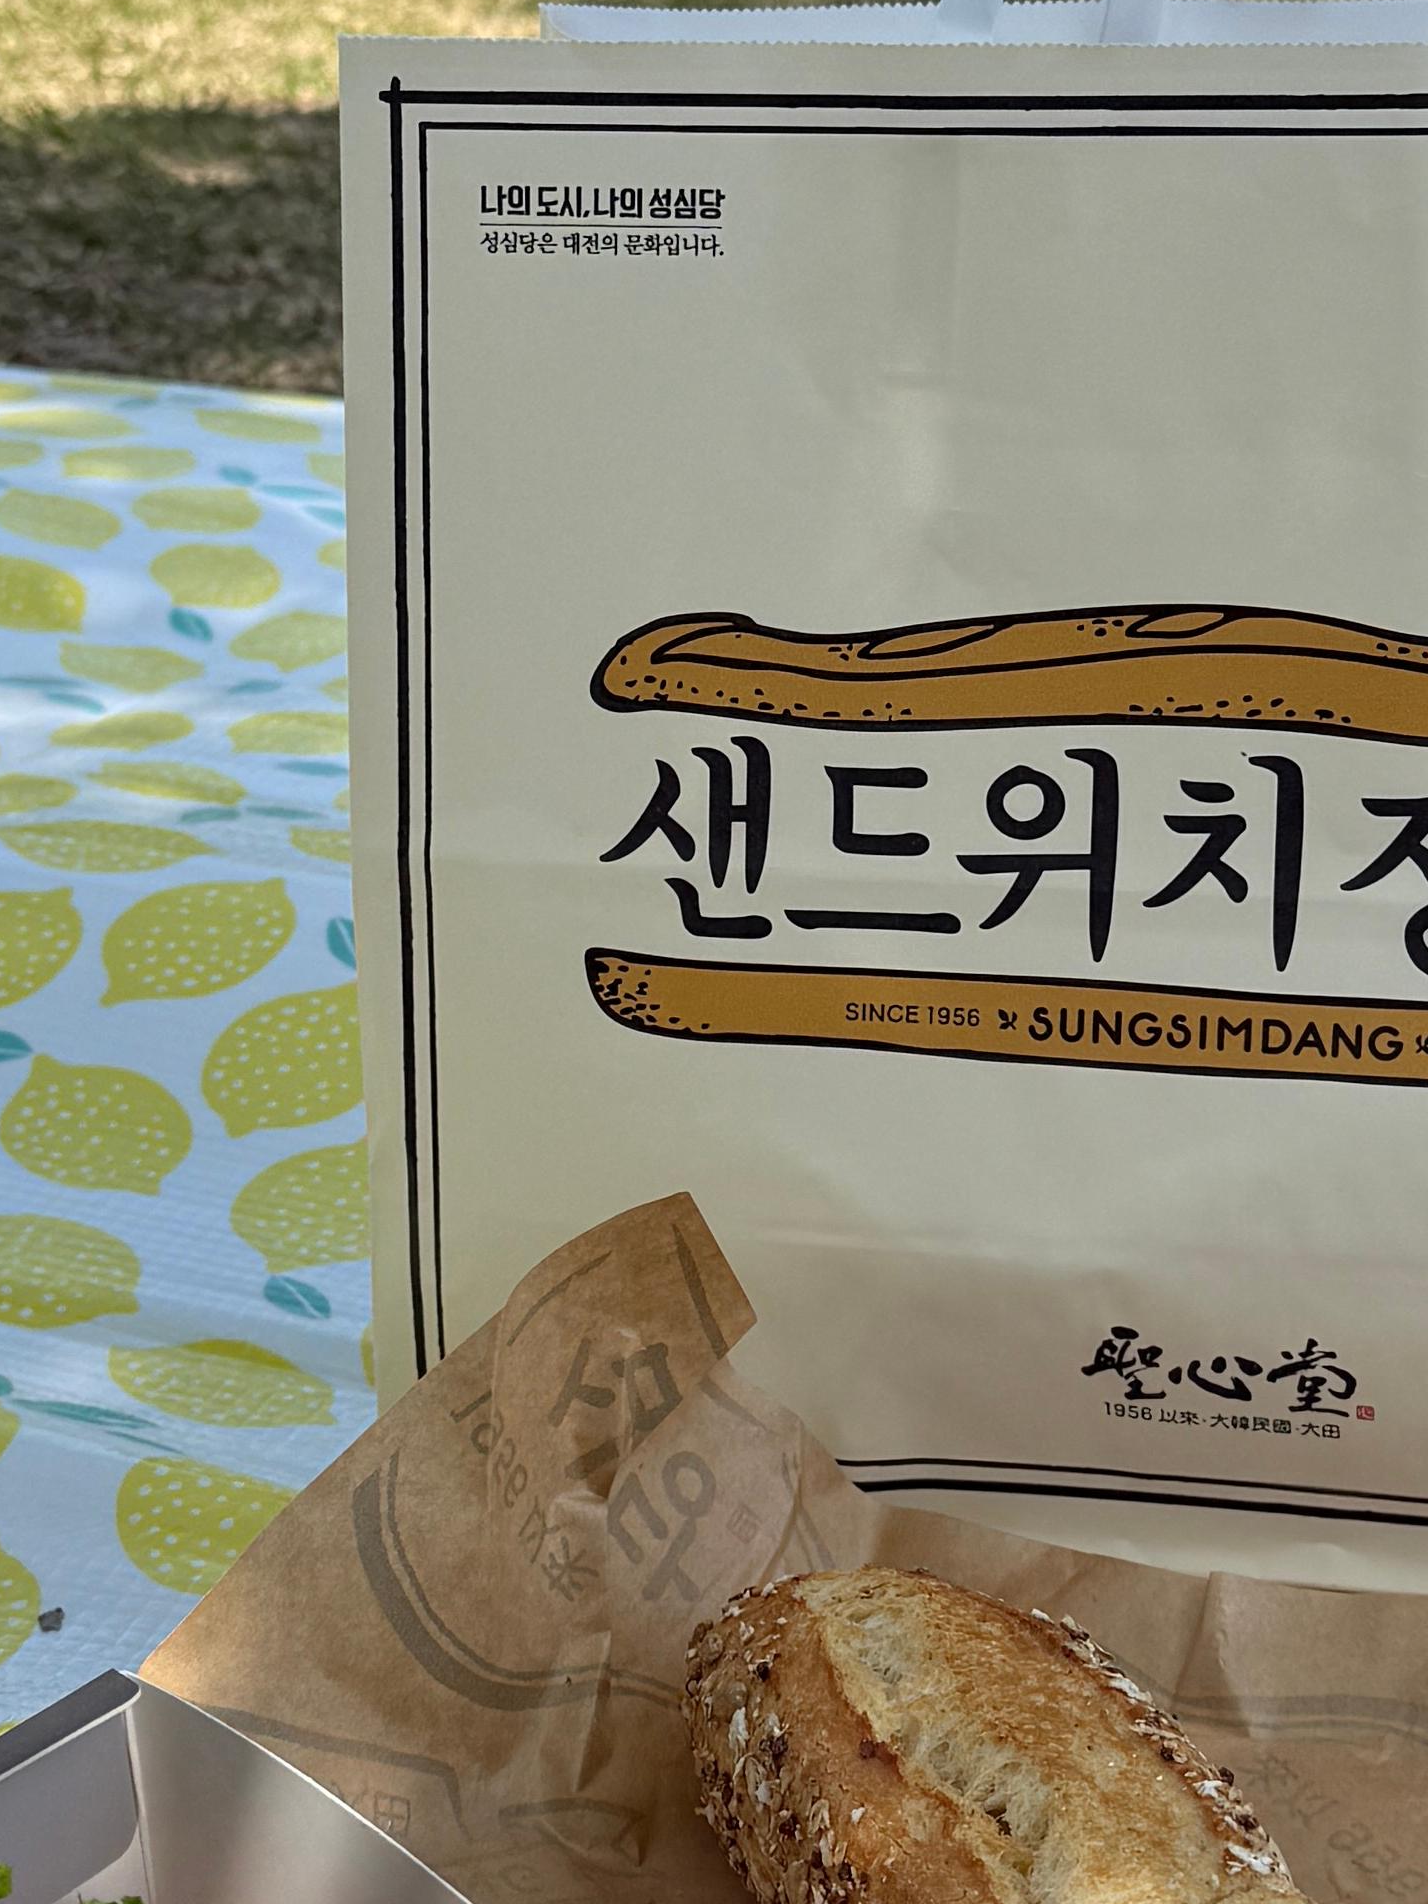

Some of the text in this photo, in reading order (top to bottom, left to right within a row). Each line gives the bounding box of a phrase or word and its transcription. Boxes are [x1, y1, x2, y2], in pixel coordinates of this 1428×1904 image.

[480, 184, 530, 216] 나의
[649, 188, 726, 219] 성심당
[479, 231, 725, 258] 성심당은 대전의 문화입니다.
[844, 1001, 920, 1025] SINCE
[926, 1005, 981, 1027] 1956
[1028, 1006, 1404, 1062] SUNGSIMDANG
[1080, 1325, 1358, 1418] 聖心堂
